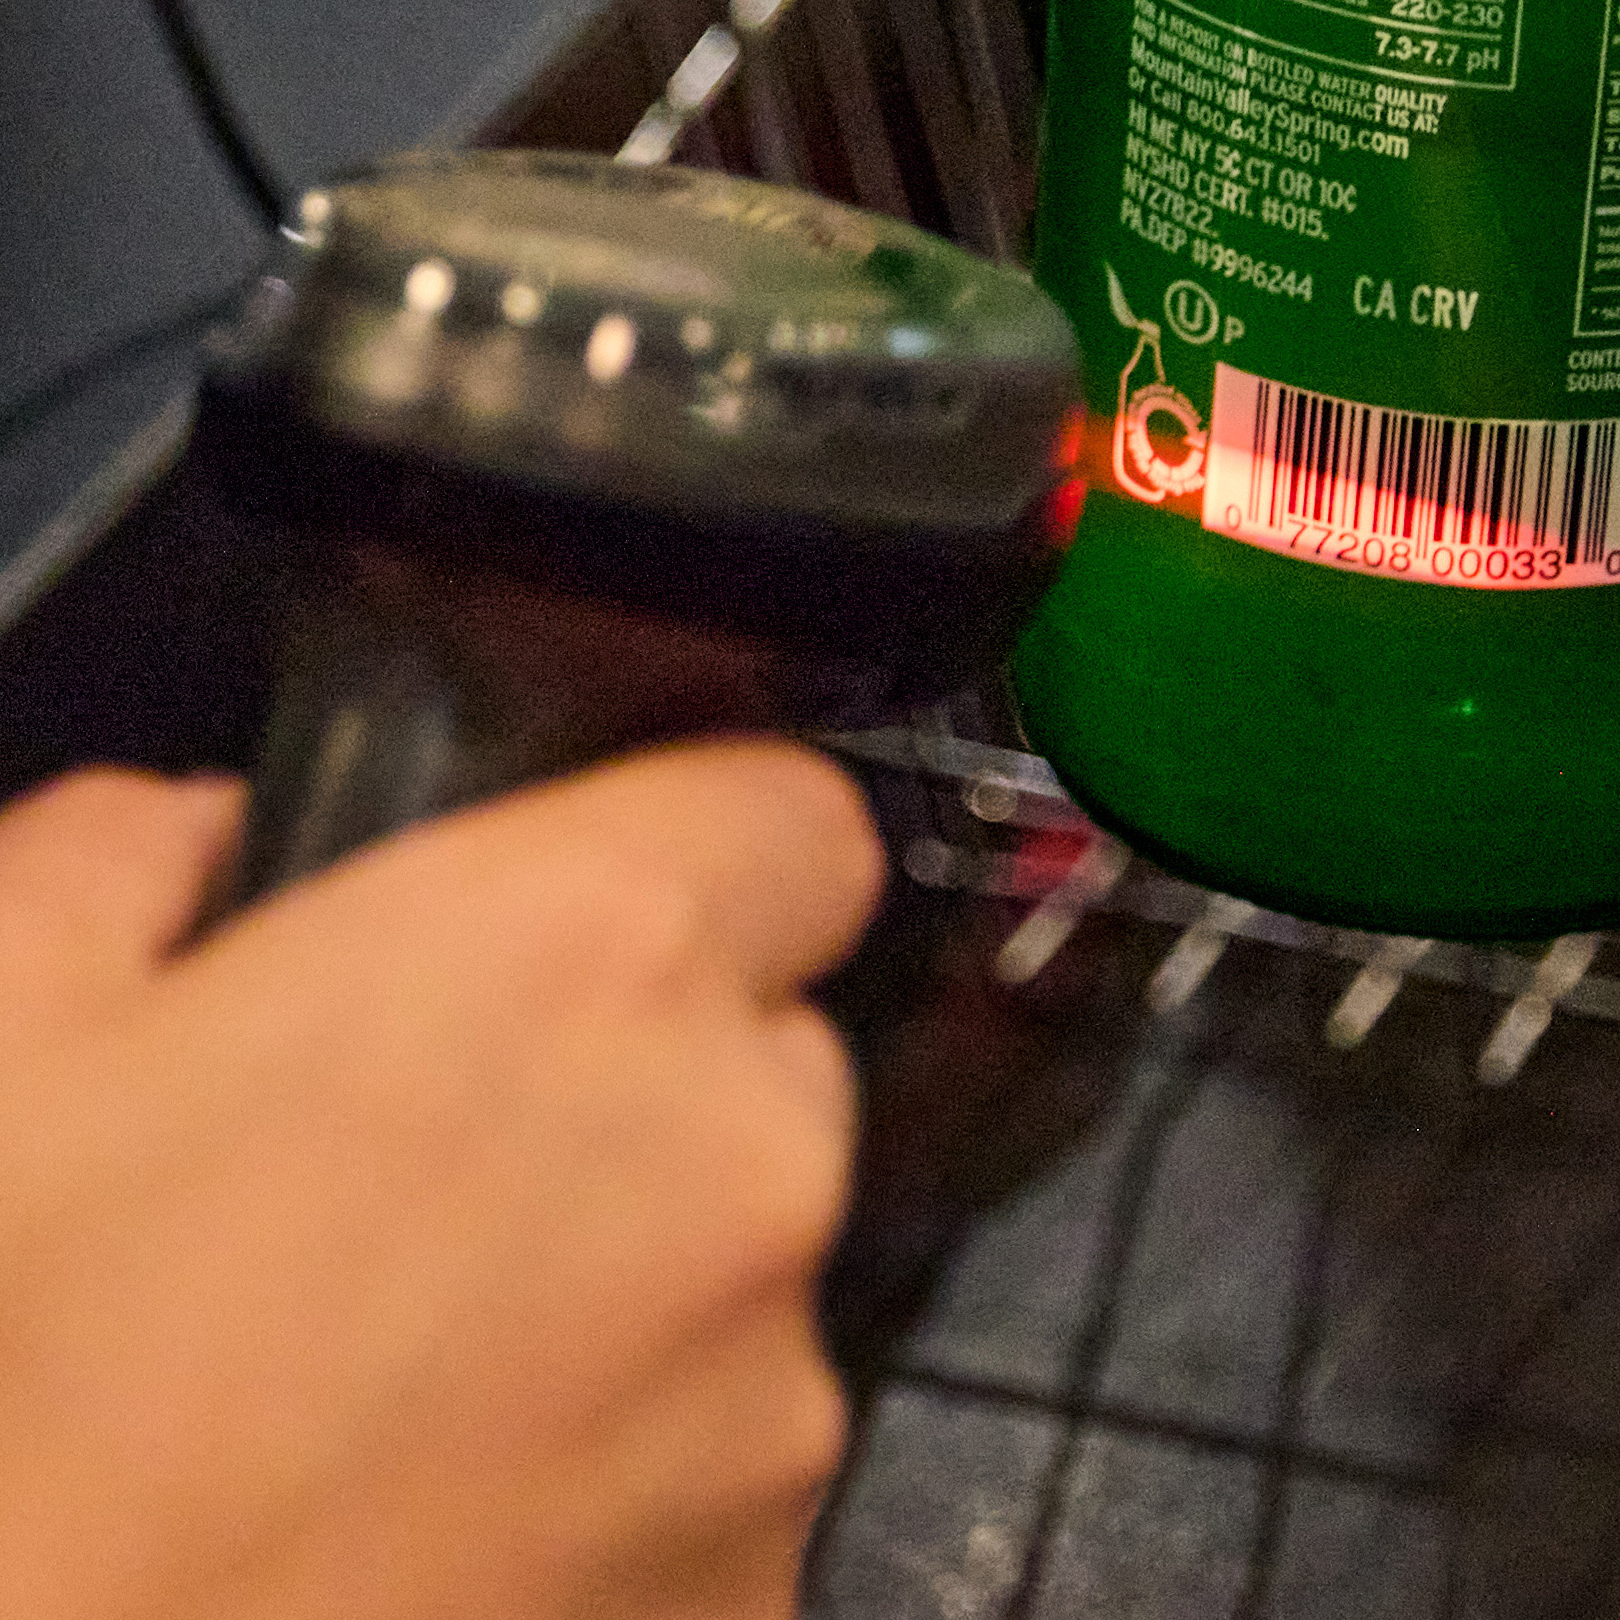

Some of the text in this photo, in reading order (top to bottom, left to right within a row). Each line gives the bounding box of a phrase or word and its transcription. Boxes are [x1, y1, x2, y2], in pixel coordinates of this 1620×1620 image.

[1158, 30, 1248, 84] INFORMATION
[1250, 70, 1307, 105] PLEASE
[1311, 90, 1383, 122] CONTACT
[1387, 106, 1411, 130] US
[1169, 14, 1220, 52] REPORT
[1247, 47, 1315, 86] BOTTLED
[1318, 70, 1371, 99] WATER
[1374, 84, 1448, 115] QUALITY
[1374, 30, 1501, 74] 7.3-7.7 pH
[1128, 65, 1146, 93] Or
[1150, 80, 1183, 115] Call
[1131, 34, 1410, 160] MountainValleySpring.com
[1126, 131, 1190, 191] NYSHD
[1129, 99, 1148, 136] HI
[1150, 113, 1179, 153] ME
[1181, 130, 1212, 165] NY
[1245, 156, 1275, 190] CT
[1279, 166, 1313, 202] OR
[1192, 238, 1314, 302] #9996244
[1223, 314, 1246, 345] P
[1353, 273, 1479, 332] CA CRV
[1225, 503, 1243, 531] 0
[1286, 518, 1412, 572] 77208
[1432, 545, 1562, 581] 00033
